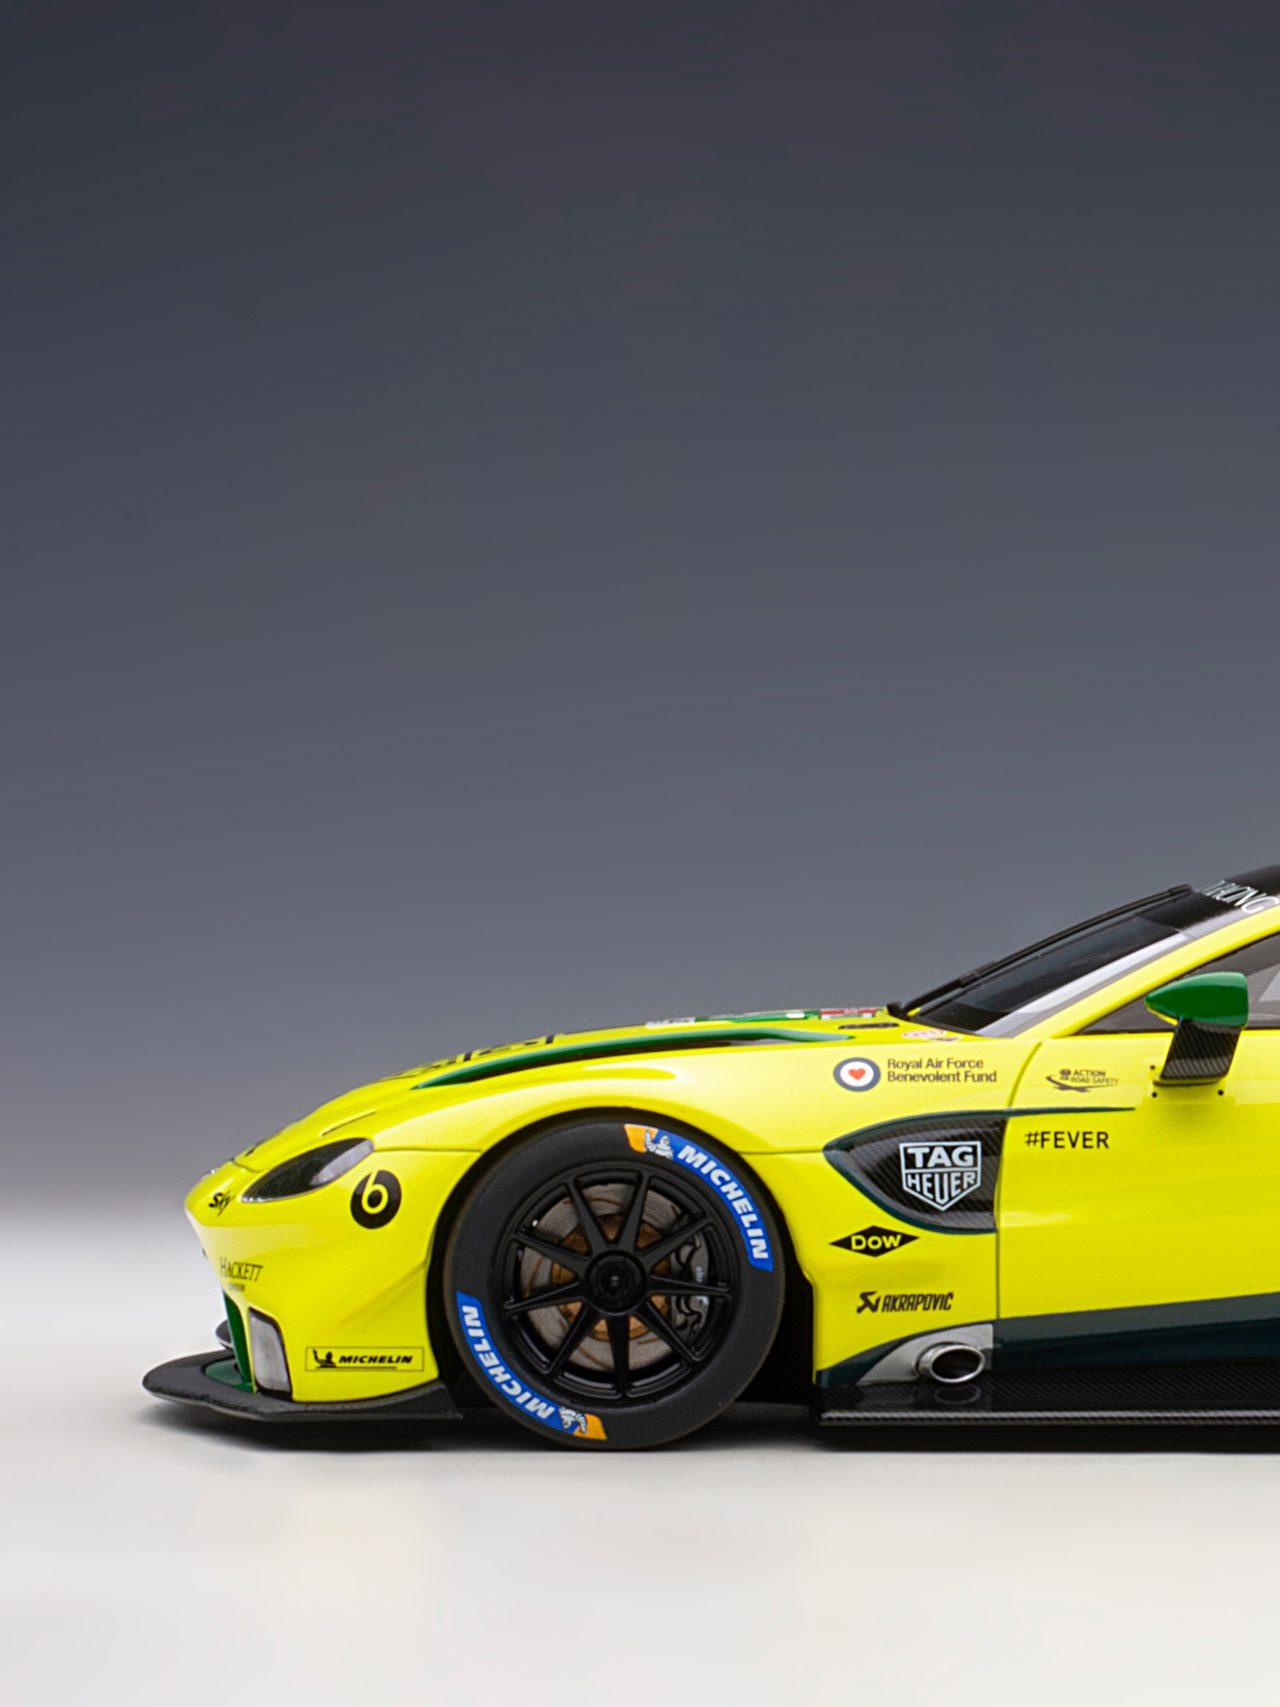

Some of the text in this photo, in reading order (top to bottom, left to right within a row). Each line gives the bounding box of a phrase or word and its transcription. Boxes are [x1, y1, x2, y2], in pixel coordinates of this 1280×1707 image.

[887, 1057, 984, 1073] Royal Air Force
[1073, 1069, 1106, 1077] ACTION
[887, 1070, 997, 1083] Benevolent Fund
[1025, 1131, 1109, 1149] #FEVER
[907, 1146, 974, 1168] TAG
[907, 1172, 976, 1205] HEUER
[677, 1145, 769, 1259] MICHELIN
[851, 1234, 902, 1250] DOW
[219, 1256, 263, 1281] HACKETT
[338, 1355, 413, 1364] MICHELIN
[462, 1305, 556, 1420] MICHELIN
